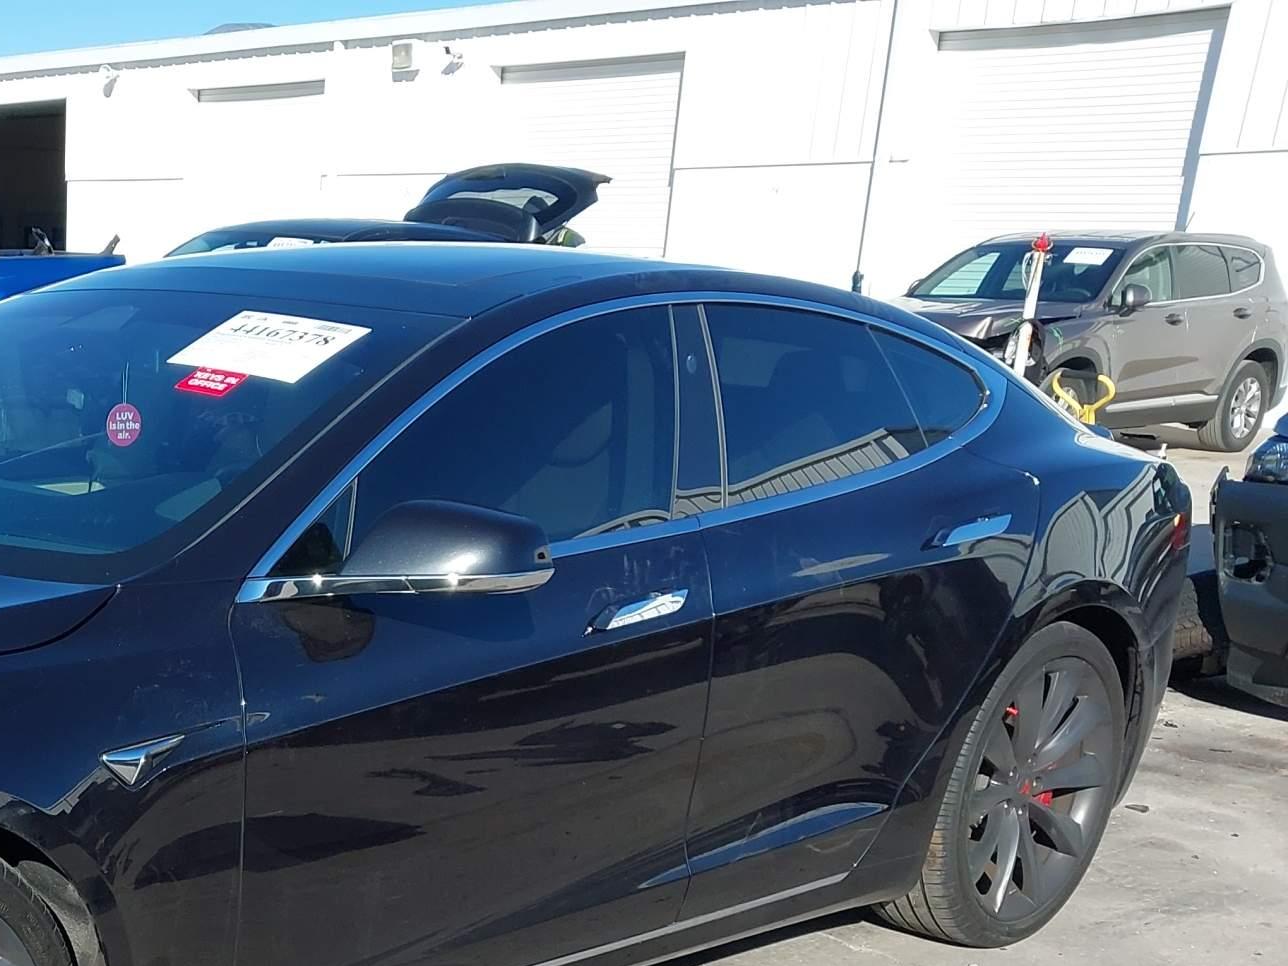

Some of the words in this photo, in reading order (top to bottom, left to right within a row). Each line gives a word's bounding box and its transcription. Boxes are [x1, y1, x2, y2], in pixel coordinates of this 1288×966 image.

[230, 323, 336, 346] 44167378
[193, 371, 226, 382] KEYS
[223, 376, 241, 385] IN
[187, 379, 229, 391] OFFICE
[116, 411, 134, 421] LUV
[125, 420, 140, 430] the
